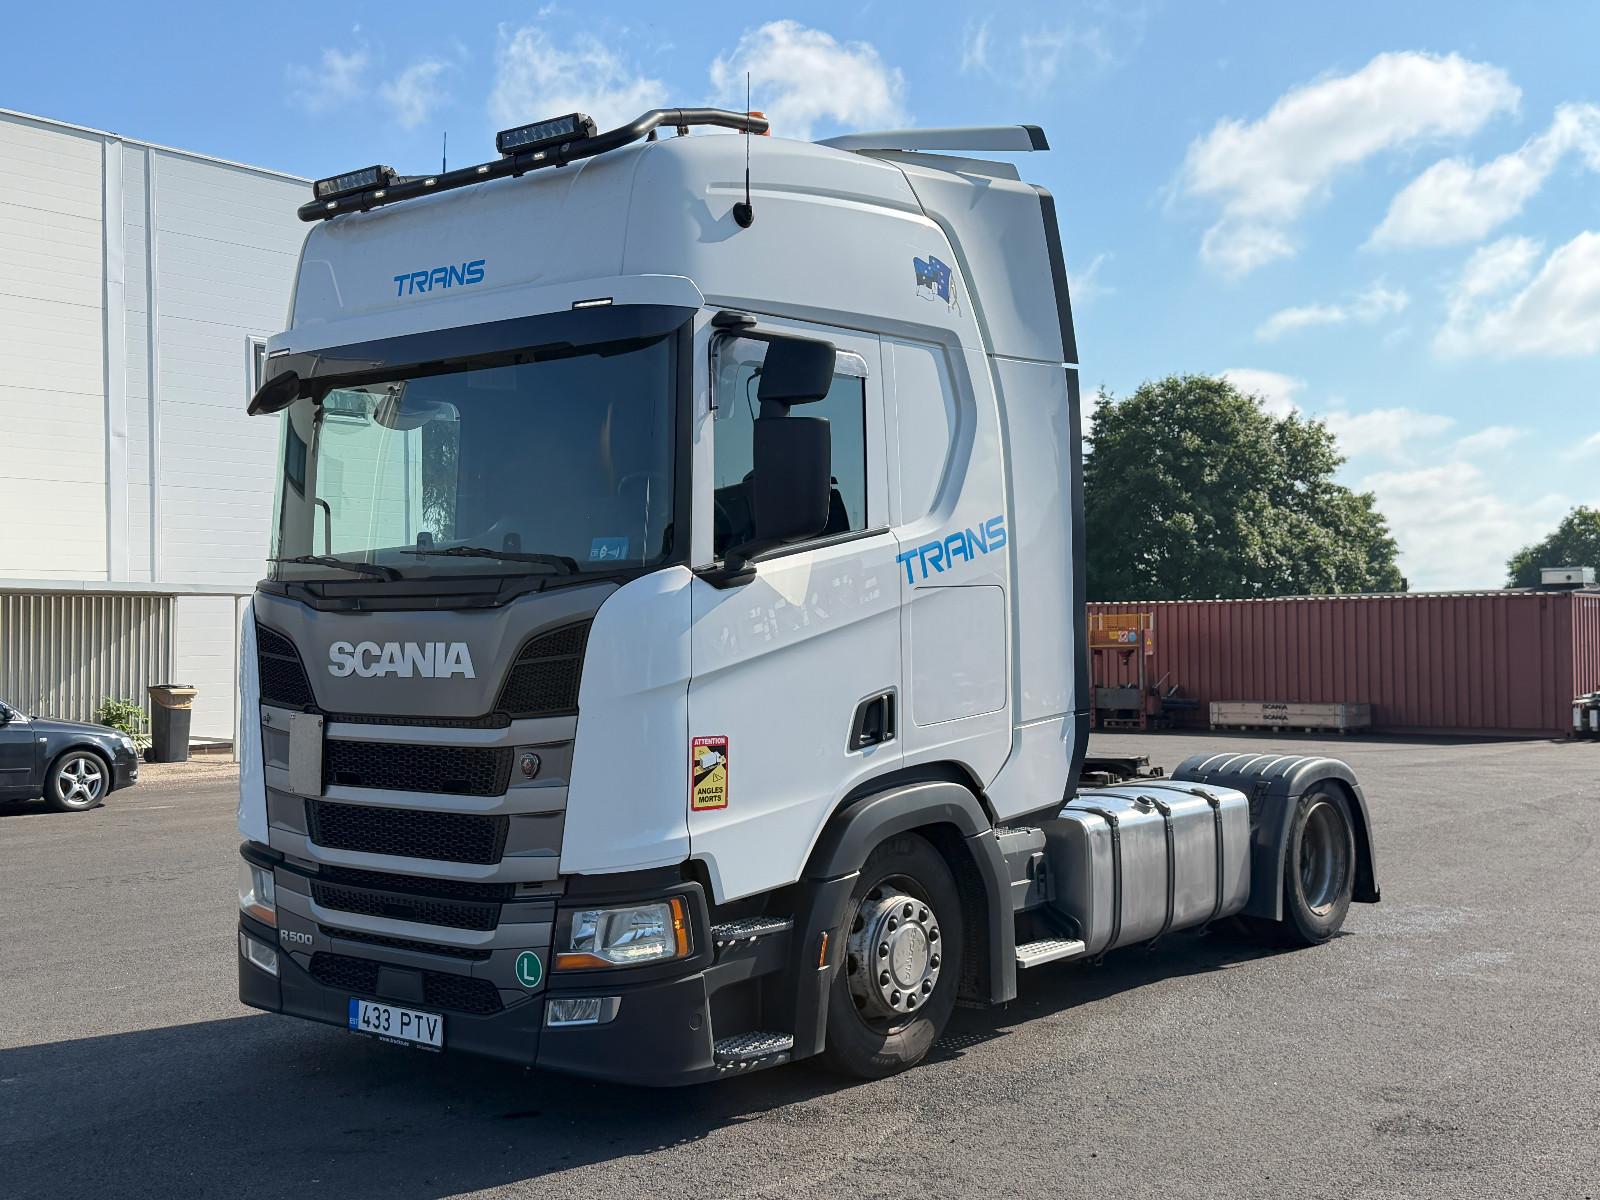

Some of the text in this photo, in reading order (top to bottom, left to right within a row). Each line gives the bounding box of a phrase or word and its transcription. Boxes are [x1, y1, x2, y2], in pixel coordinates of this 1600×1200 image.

[393, 259, 486, 297] TRANS
[895, 515, 1007, 585] TRANS
[327, 641, 476, 679] SCANIA
[698, 787, 723, 795] ANGLES
[698, 795, 721, 803] MORTS
[280, 929, 313, 945] R500
[523, 957, 535, 981] L
[362, 1004, 391, 1032] 433
[400, 1011, 438, 1042] PTV
